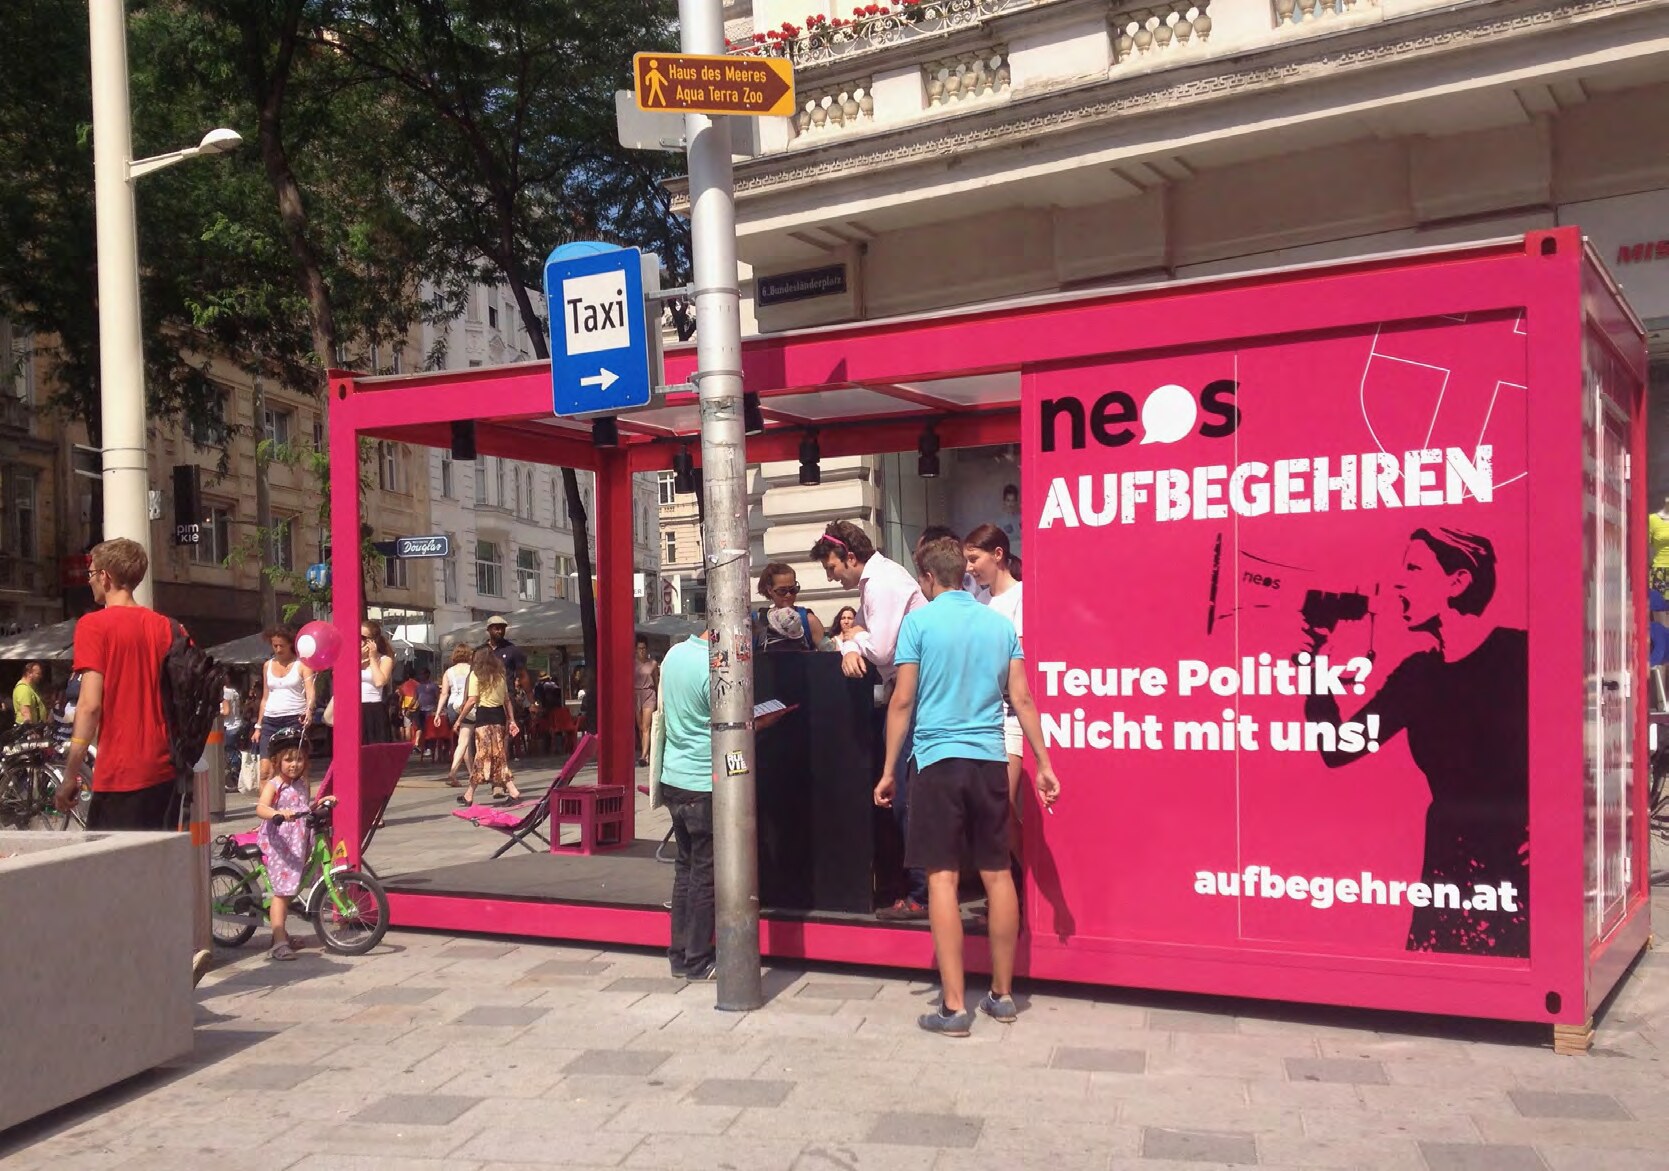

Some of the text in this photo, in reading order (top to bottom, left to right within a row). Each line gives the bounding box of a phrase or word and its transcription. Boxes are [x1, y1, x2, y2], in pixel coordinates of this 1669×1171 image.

[669, 64, 767, 83] Haus des Meeres
[676, 84, 763, 104] Aqua Terra Zoo
[567, 288, 624, 334] Taxi
[1038, 445, 1493, 529] AUFBEGEHREN
[403, 539, 442, 555] Douglas
[1038, 652, 1373, 697] Teure Politik?
[1040, 708, 1381, 753] Nicht mit uns!
[1194, 865, 1519, 913] aufbegehren.at
